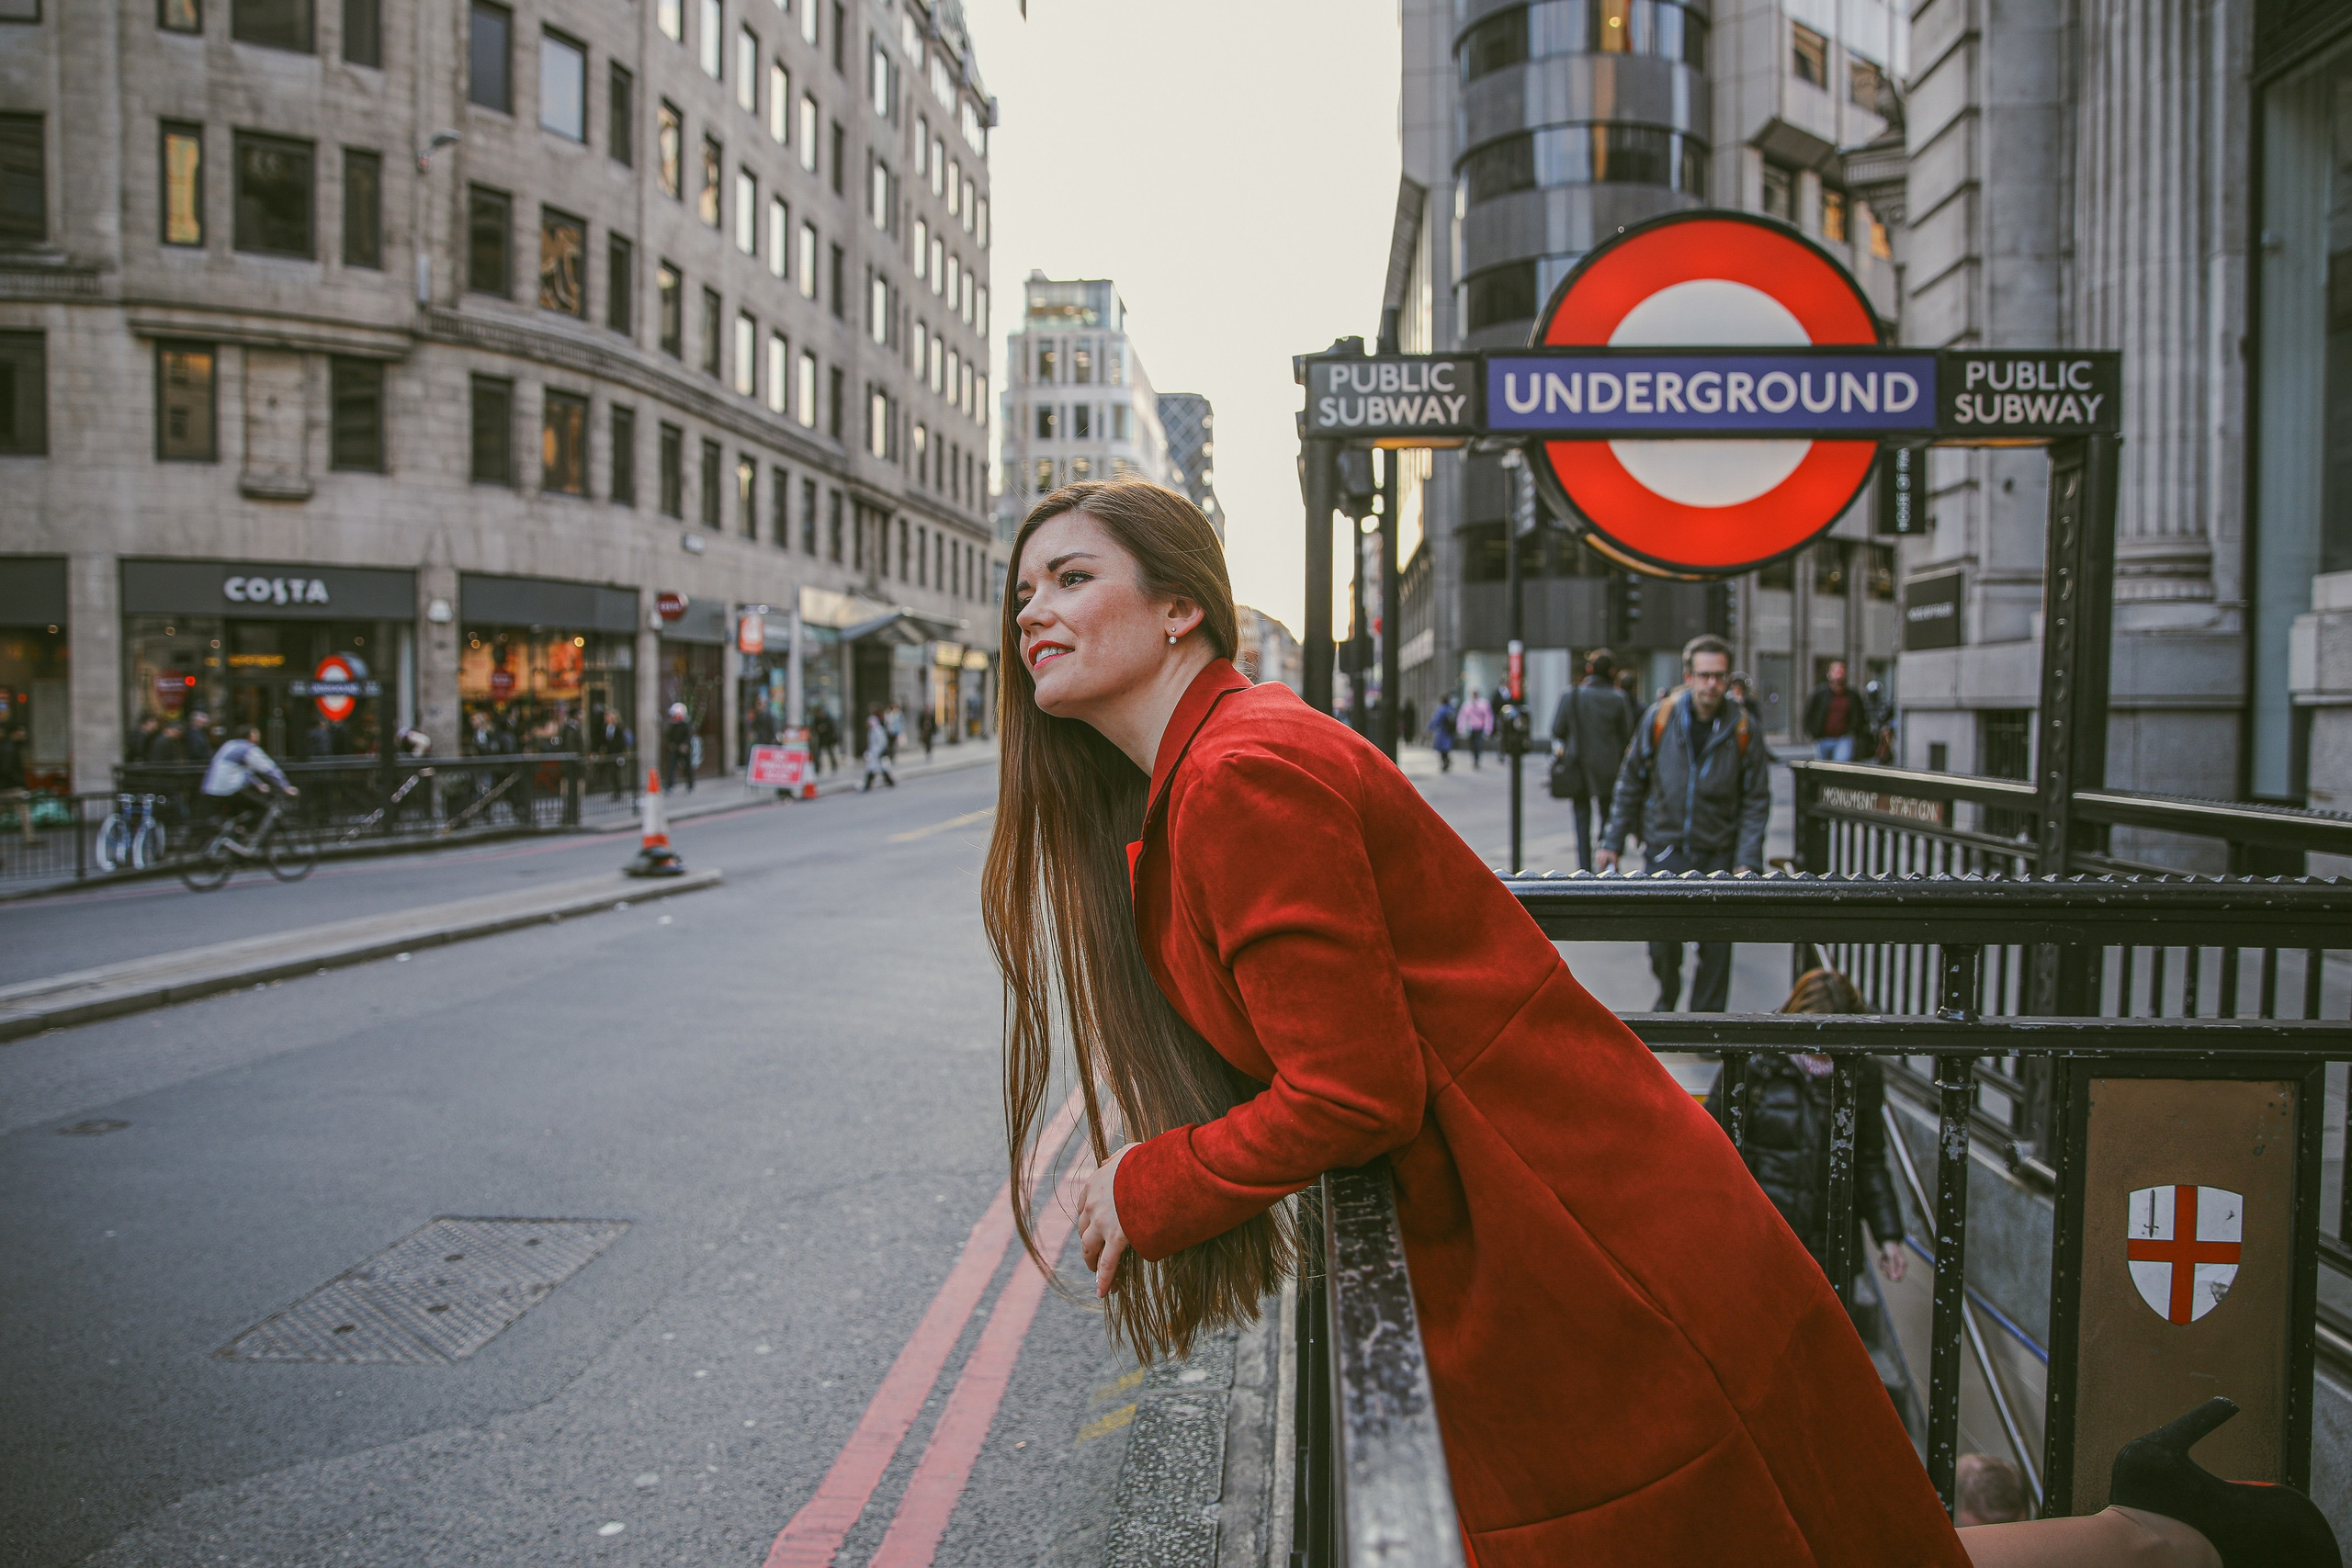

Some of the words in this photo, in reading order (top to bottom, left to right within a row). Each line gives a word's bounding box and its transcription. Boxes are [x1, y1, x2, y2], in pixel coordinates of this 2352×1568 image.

[1329, 362, 1455, 393] PUBLIC
[1965, 360, 2093, 390] PUBLIC
[1504, 371, 1919, 414] UNDERGROUND
[1318, 395, 1466, 426] SUBWAY
[1954, 393, 2104, 424] SUBWAY
[223, 577, 330, 605] COSTA
[1823, 786, 1879, 810] MONUMENT
[1889, 795, 1939, 821] STATION
